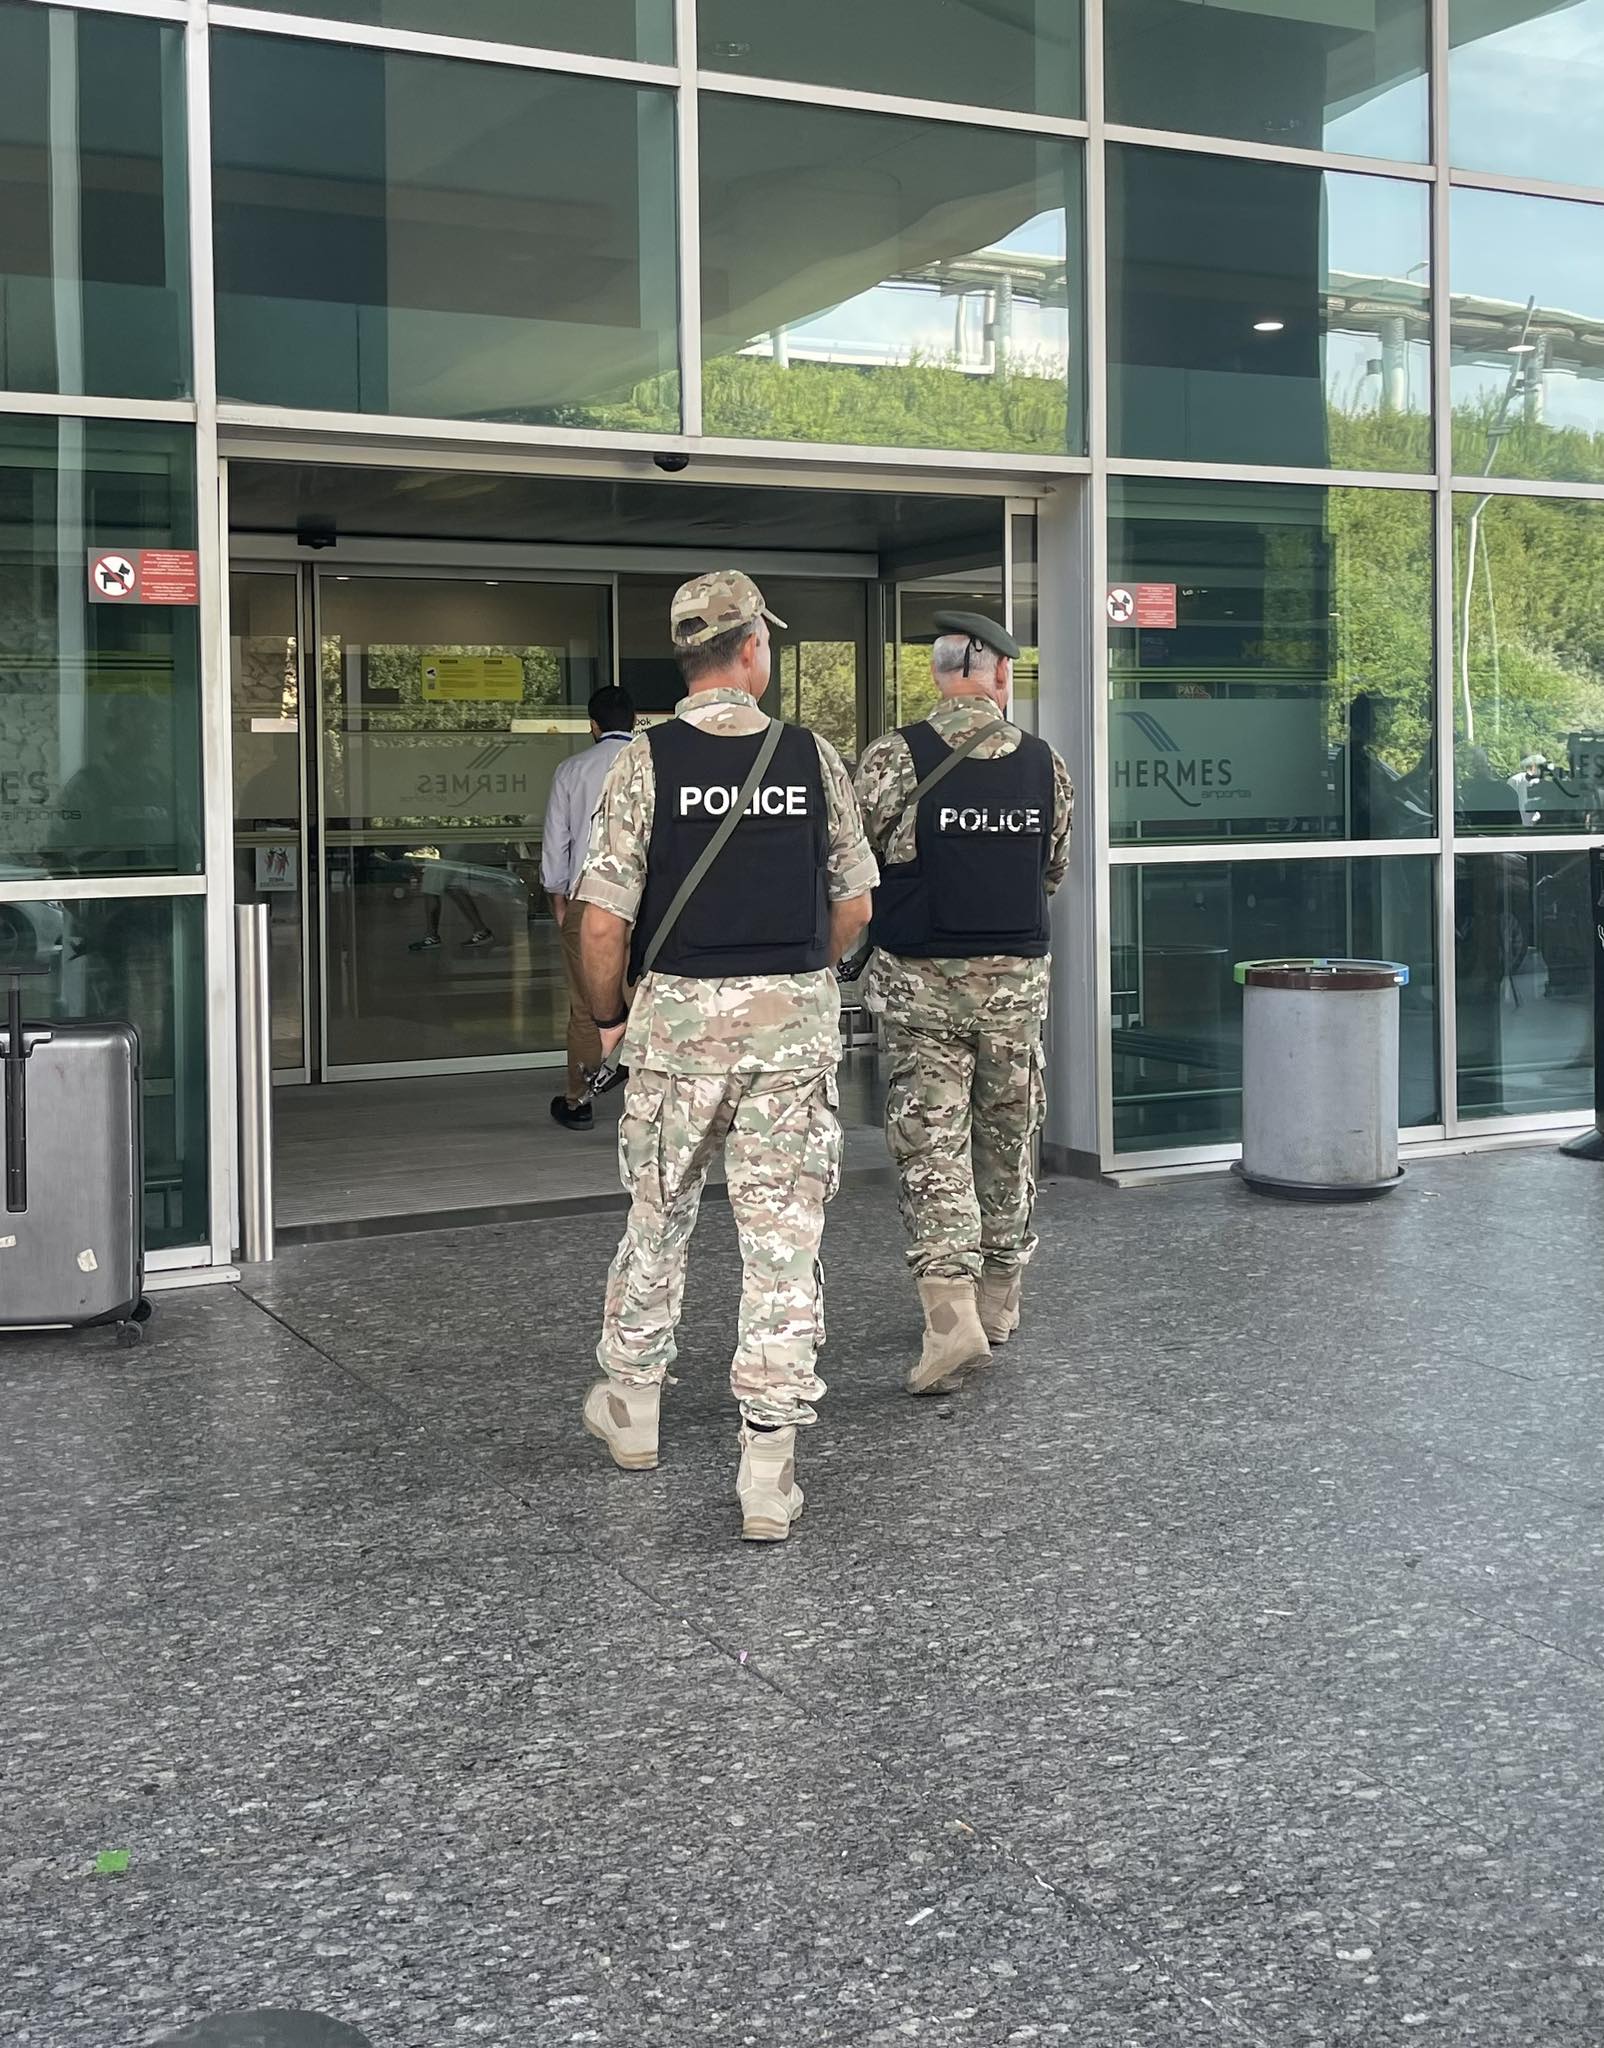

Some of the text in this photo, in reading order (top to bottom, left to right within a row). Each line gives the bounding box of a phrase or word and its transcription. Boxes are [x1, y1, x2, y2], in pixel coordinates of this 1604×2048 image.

[633, 717, 652, 726] ook
[1114, 759, 1232, 807] HERMES
[680, 785, 807, 816] POLICE
[940, 807, 1041, 832] POLICE
